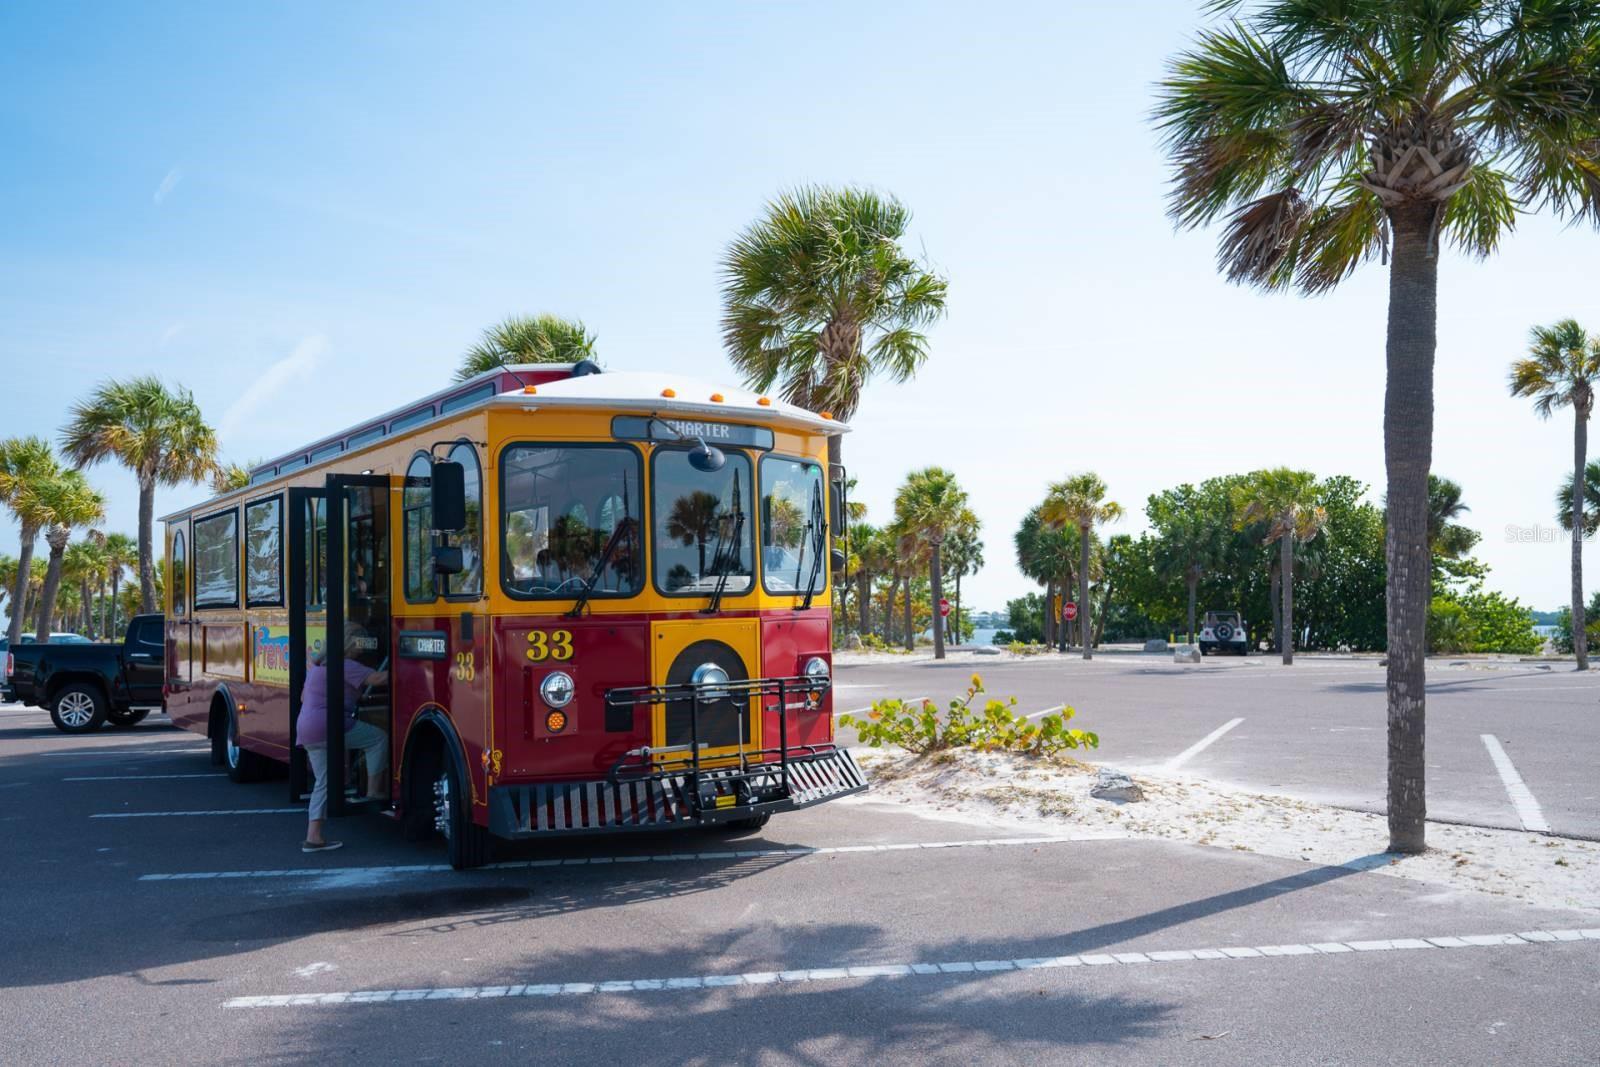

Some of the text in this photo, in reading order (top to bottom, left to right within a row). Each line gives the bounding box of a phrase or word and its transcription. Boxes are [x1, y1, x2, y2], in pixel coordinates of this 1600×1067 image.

[666, 420, 730, 438] CHARTER
[417, 638, 446, 653] CHARTER
[526, 629, 575, 661] 33
[456, 652, 475, 681] 33
